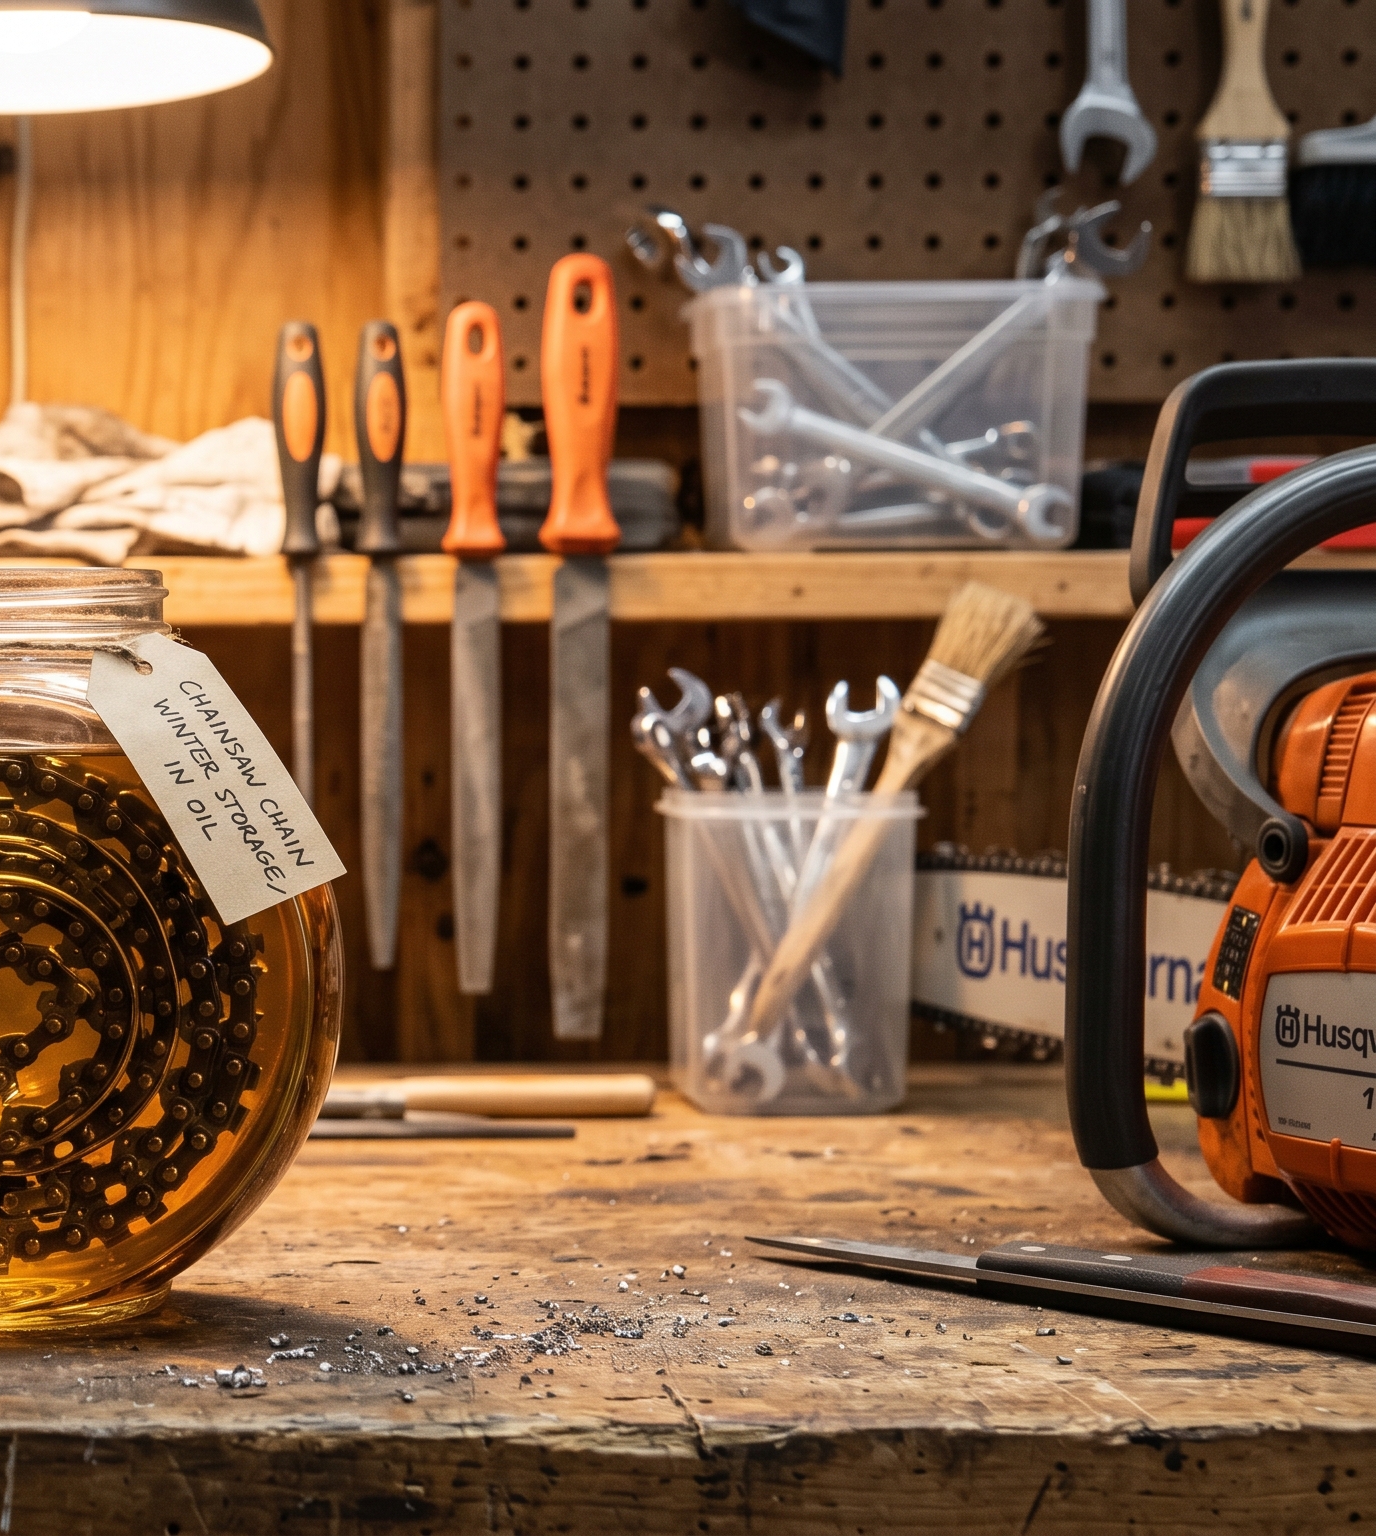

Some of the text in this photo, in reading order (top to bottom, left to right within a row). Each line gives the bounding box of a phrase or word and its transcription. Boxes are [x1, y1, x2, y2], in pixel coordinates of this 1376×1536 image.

[154, 698, 220, 780] WINTER
[179, 681, 315, 867] CHAINSAW CHAIN
[164, 761, 218, 842] IN OIL
